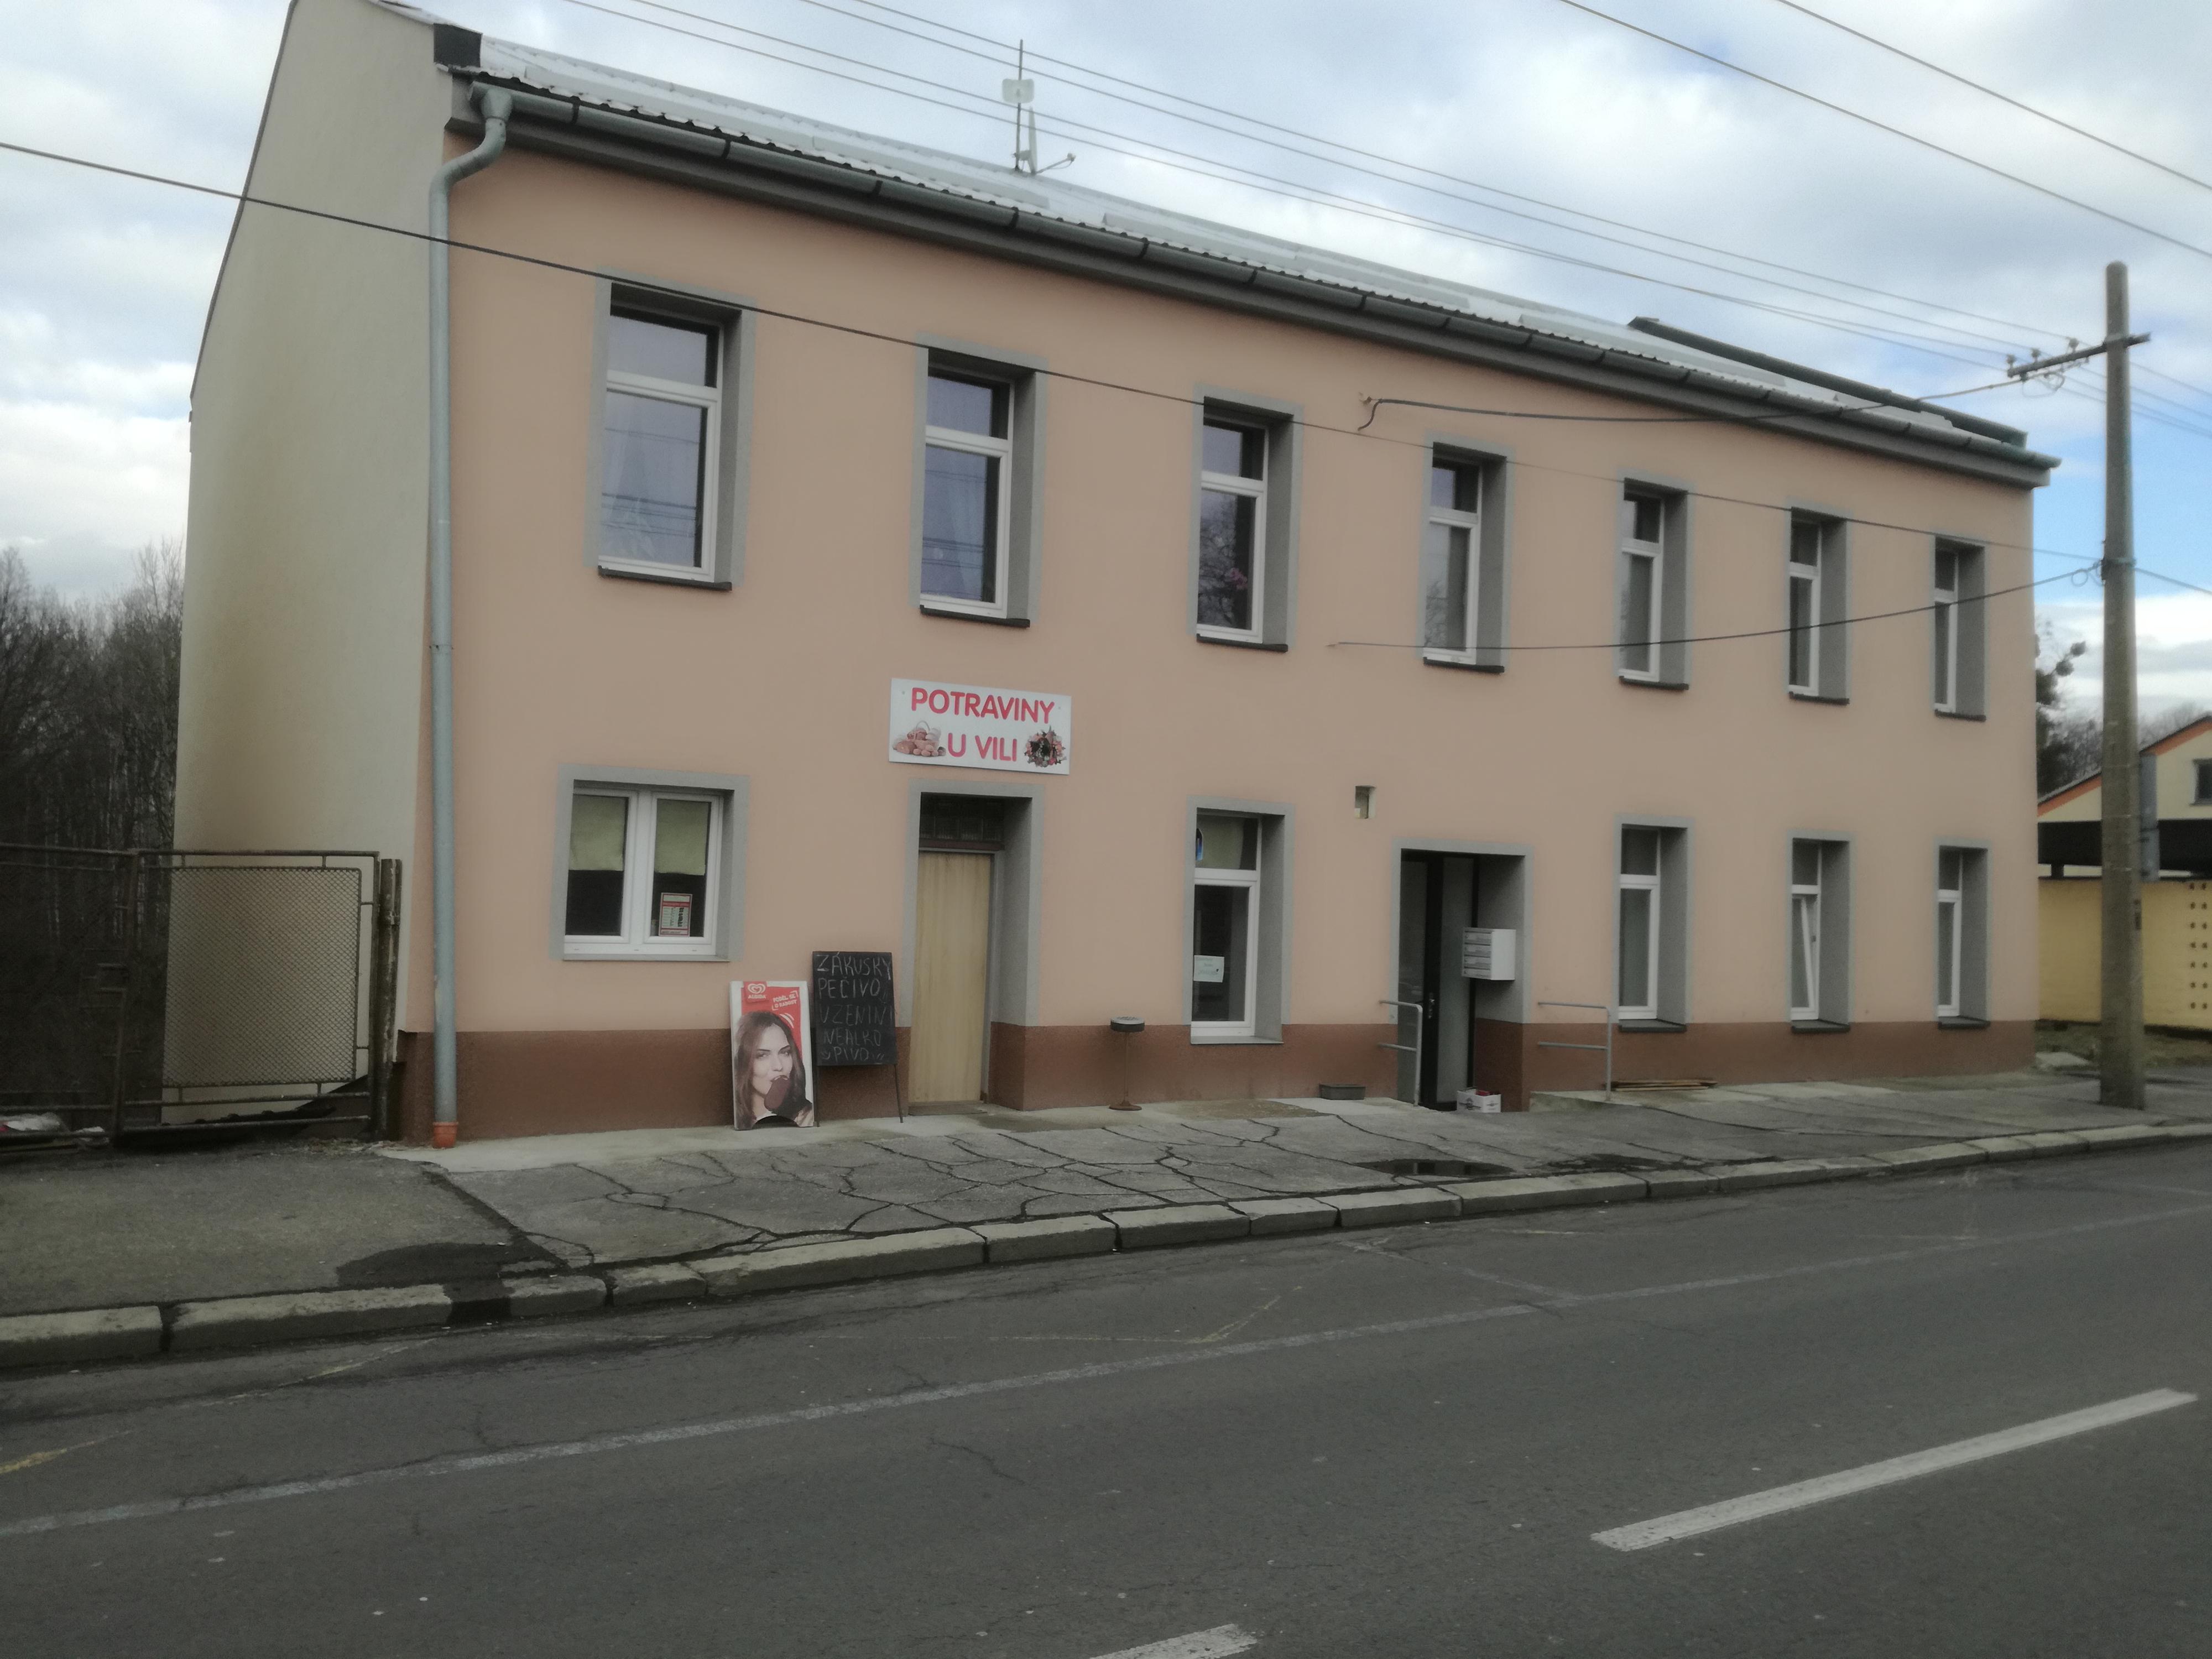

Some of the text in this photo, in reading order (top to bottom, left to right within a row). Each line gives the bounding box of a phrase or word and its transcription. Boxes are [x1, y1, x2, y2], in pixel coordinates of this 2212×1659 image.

[911, 687, 1055, 724] POTRAVINY
[947, 733, 1017, 761] U VILI
[816, 951, 891, 980] ZÁKUSKY
[818, 976, 880, 999] PEČIVO
